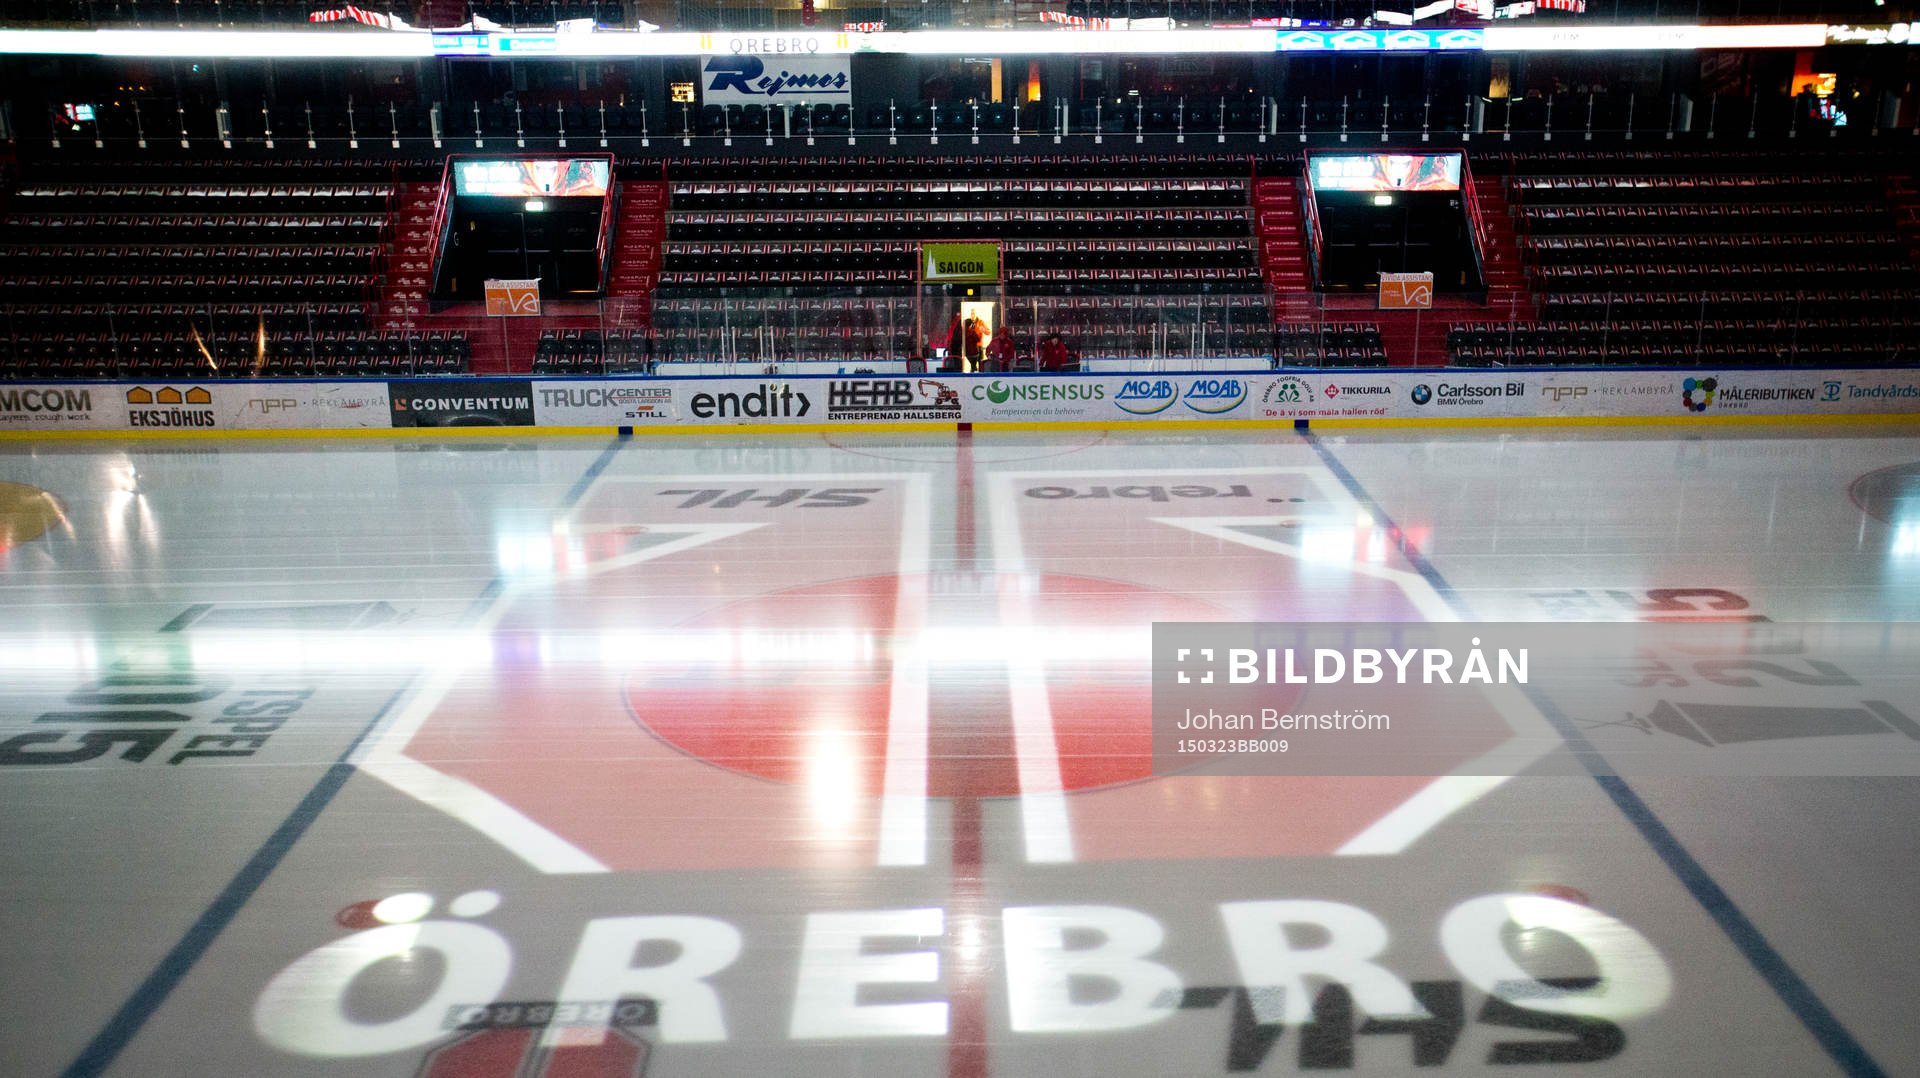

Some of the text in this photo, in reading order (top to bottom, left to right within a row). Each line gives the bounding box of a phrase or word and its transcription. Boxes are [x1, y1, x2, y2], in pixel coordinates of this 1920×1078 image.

[938, 261, 984, 274] SAIGON
[828, 380, 914, 405] HEAB
[971, 380, 1105, 404] CONSENSUS
[1114, 380, 1173, 399] MOAB
[1183, 379, 1242, 398] MOAB
[1341, 385, 1391, 395] TIKKURILA
[1437, 383, 1525, 398] Carlsson Bil
[1601, 383, 1675, 395] REKLAMBYRÅ
[1719, 385, 1815, 401] MÅLERIBUTIKEN
[1847, 383, 1920, 398] Tandvårds
[412, 397, 529, 412] CONVENTUM
[1437, 397, 1484, 406] BMW Örebro
[129, 407, 215, 427] EKSJÖHUS
[828, 411, 962, 421] ENTREPRENAD HALLSBERG
[1298, 408, 1317, 416] som
[252, 890, 1672, 1057] ÖREBRO
